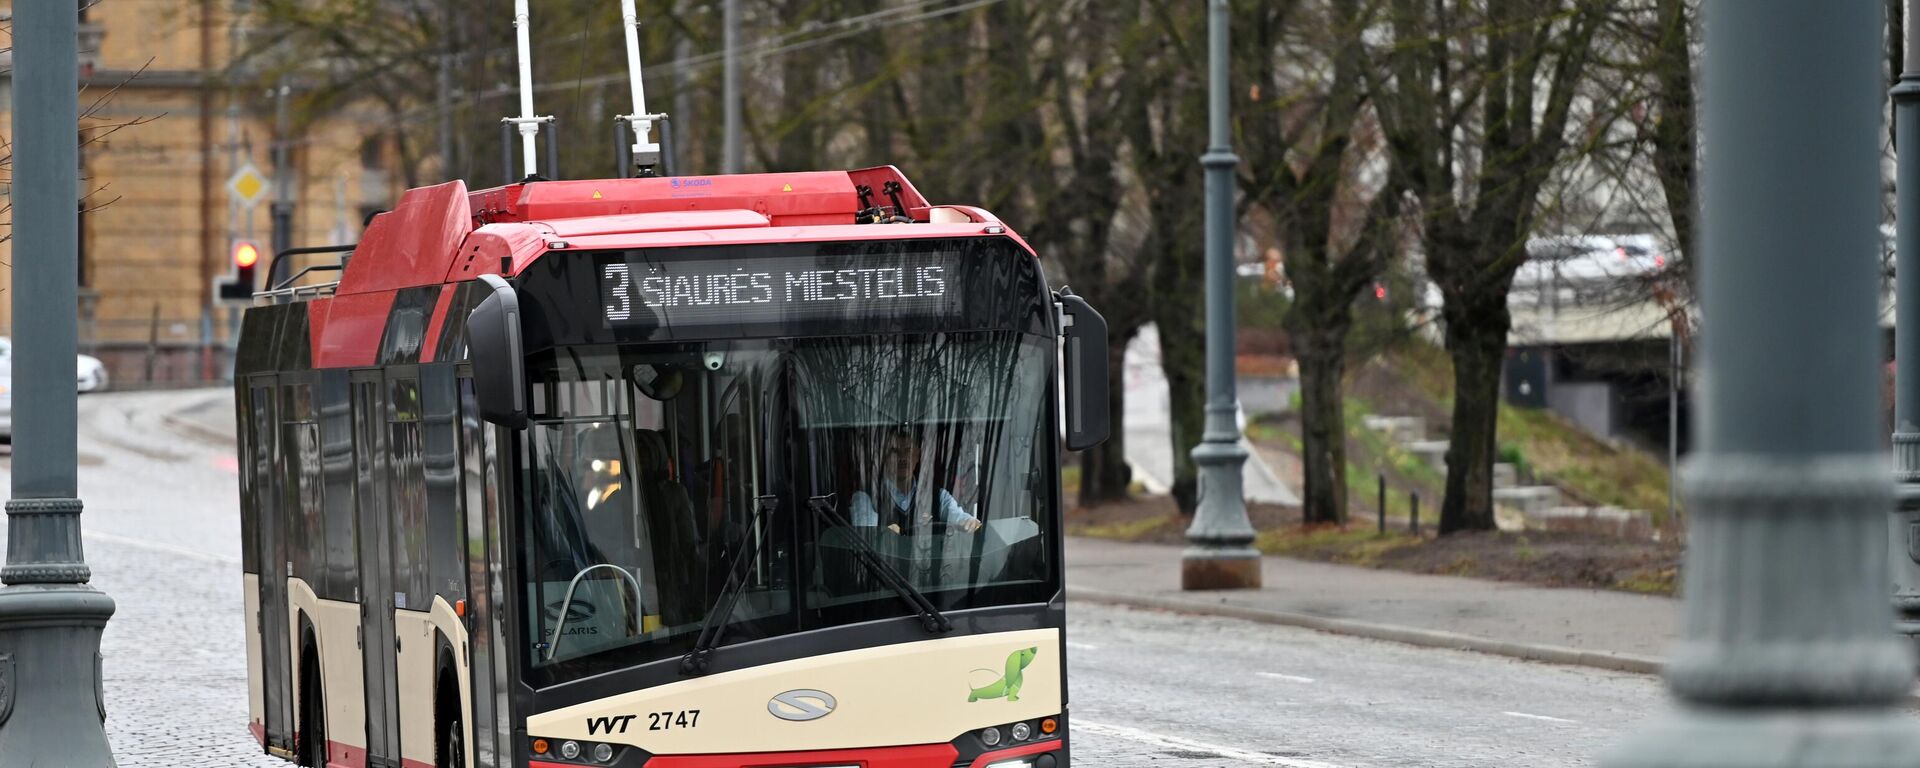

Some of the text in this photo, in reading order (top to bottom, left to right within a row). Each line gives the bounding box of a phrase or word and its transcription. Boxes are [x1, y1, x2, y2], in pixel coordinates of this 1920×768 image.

[605, 263, 944, 320] 3 ŠIAURĖS MIESTELIS
[587, 709, 700, 735] VVT 2747
